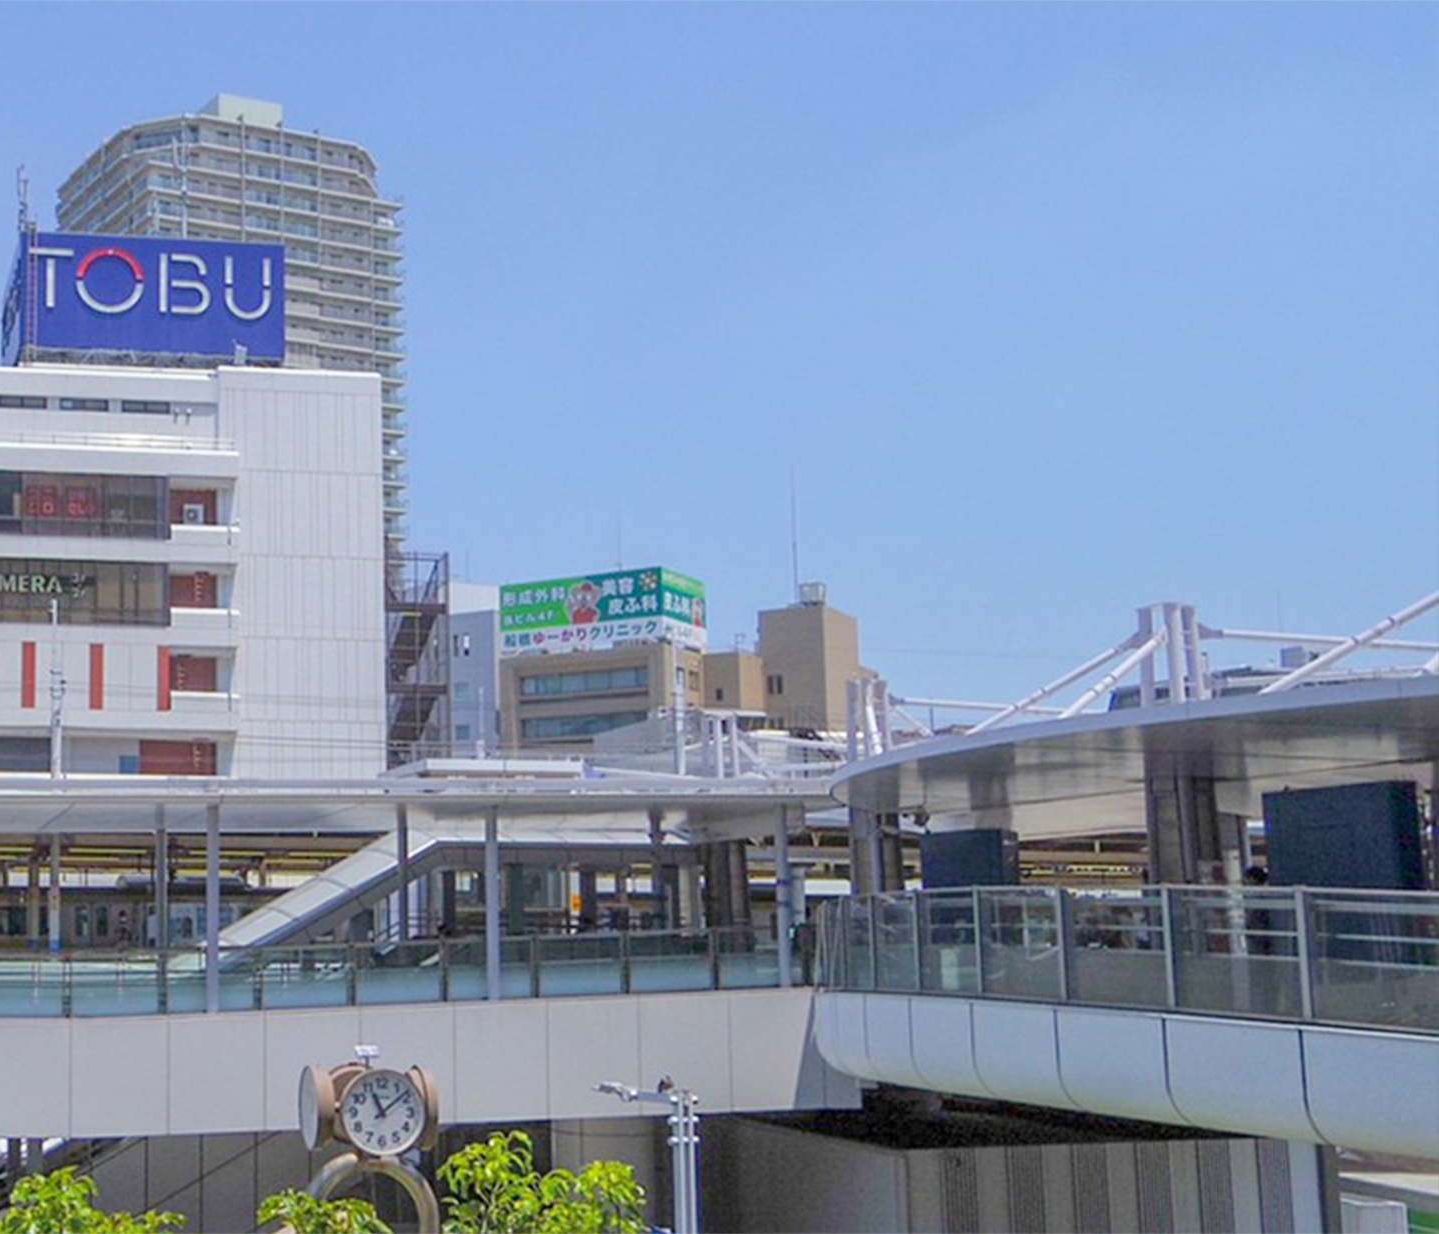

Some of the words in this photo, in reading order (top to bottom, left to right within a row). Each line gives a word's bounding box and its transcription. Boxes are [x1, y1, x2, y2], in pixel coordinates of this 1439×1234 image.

[28, 246, 272, 321] TOBU
[602, 577, 634, 596] 美容
[503, 586, 566, 607] 形成外科
[608, 594, 658, 615] 皮ふ科
[363, 1082, 374, 1093] 11
[376, 1077, 388, 1089] 12
[353, 1093, 366, 1105] 10
[349, 1107, 358, 1118] 9
[406, 1107, 414, 1119] 3
[354, 1122, 362, 1133] 8
[402, 1122, 410, 1132] 4
[365, 1131, 374, 1142] 7
[378, 1136, 386, 1147] 6
[392, 1131, 401, 1143] 5
